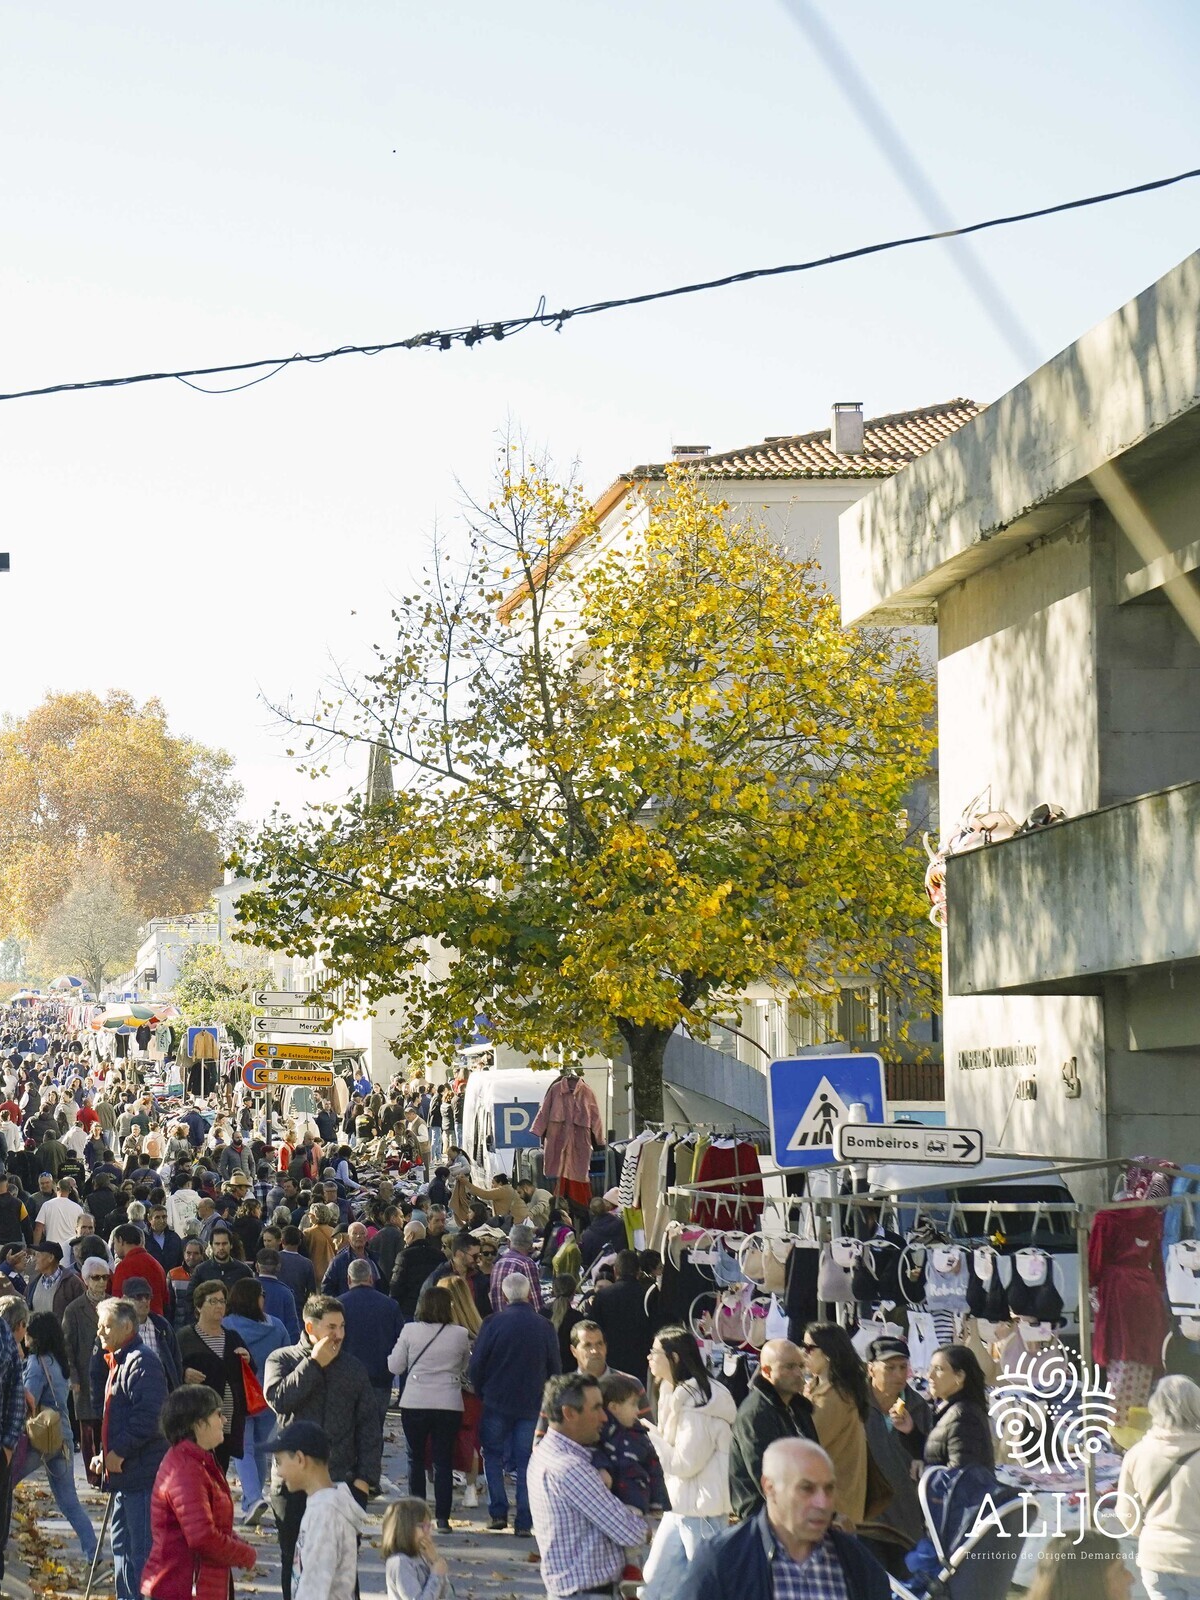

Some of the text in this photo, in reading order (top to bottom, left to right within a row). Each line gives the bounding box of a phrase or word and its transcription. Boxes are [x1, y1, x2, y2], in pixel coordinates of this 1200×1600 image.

[288, 1052, 331, 1060] Estacionamento
[308, 1046, 331, 1055] Parque
[503, 1107, 530, 1145] P
[846, 1135, 919, 1150] Bombeiros
